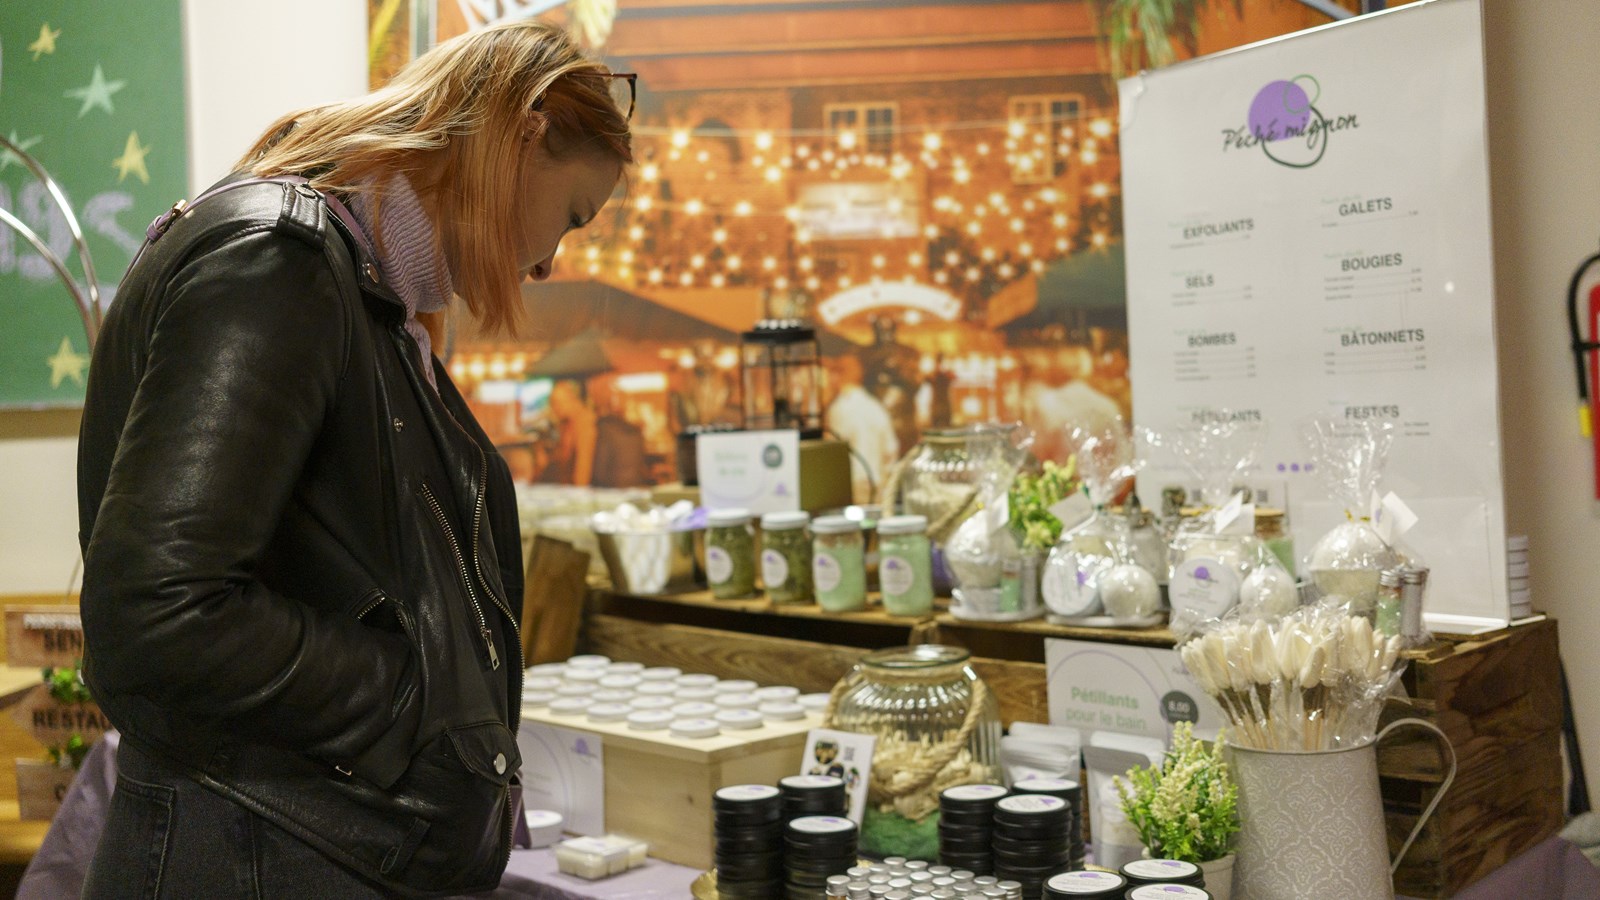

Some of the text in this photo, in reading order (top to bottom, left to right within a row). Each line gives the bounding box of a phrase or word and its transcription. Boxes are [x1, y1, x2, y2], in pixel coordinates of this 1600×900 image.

[1222, 112, 1360, 151] Péché mignon
[1339, 197, 1393, 217] GALETS
[1183, 218, 1255, 241] EXFOLIANTS
[1341, 252, 1403, 272] BOUGIES
[1185, 274, 1215, 289] SELS
[1187, 332, 1237, 348] BOMBES
[1340, 327, 1425, 347] BÂTONNETS
[1071, 686, 1139, 709] Pétillants
[1066, 709, 1146, 730] pour le bain
